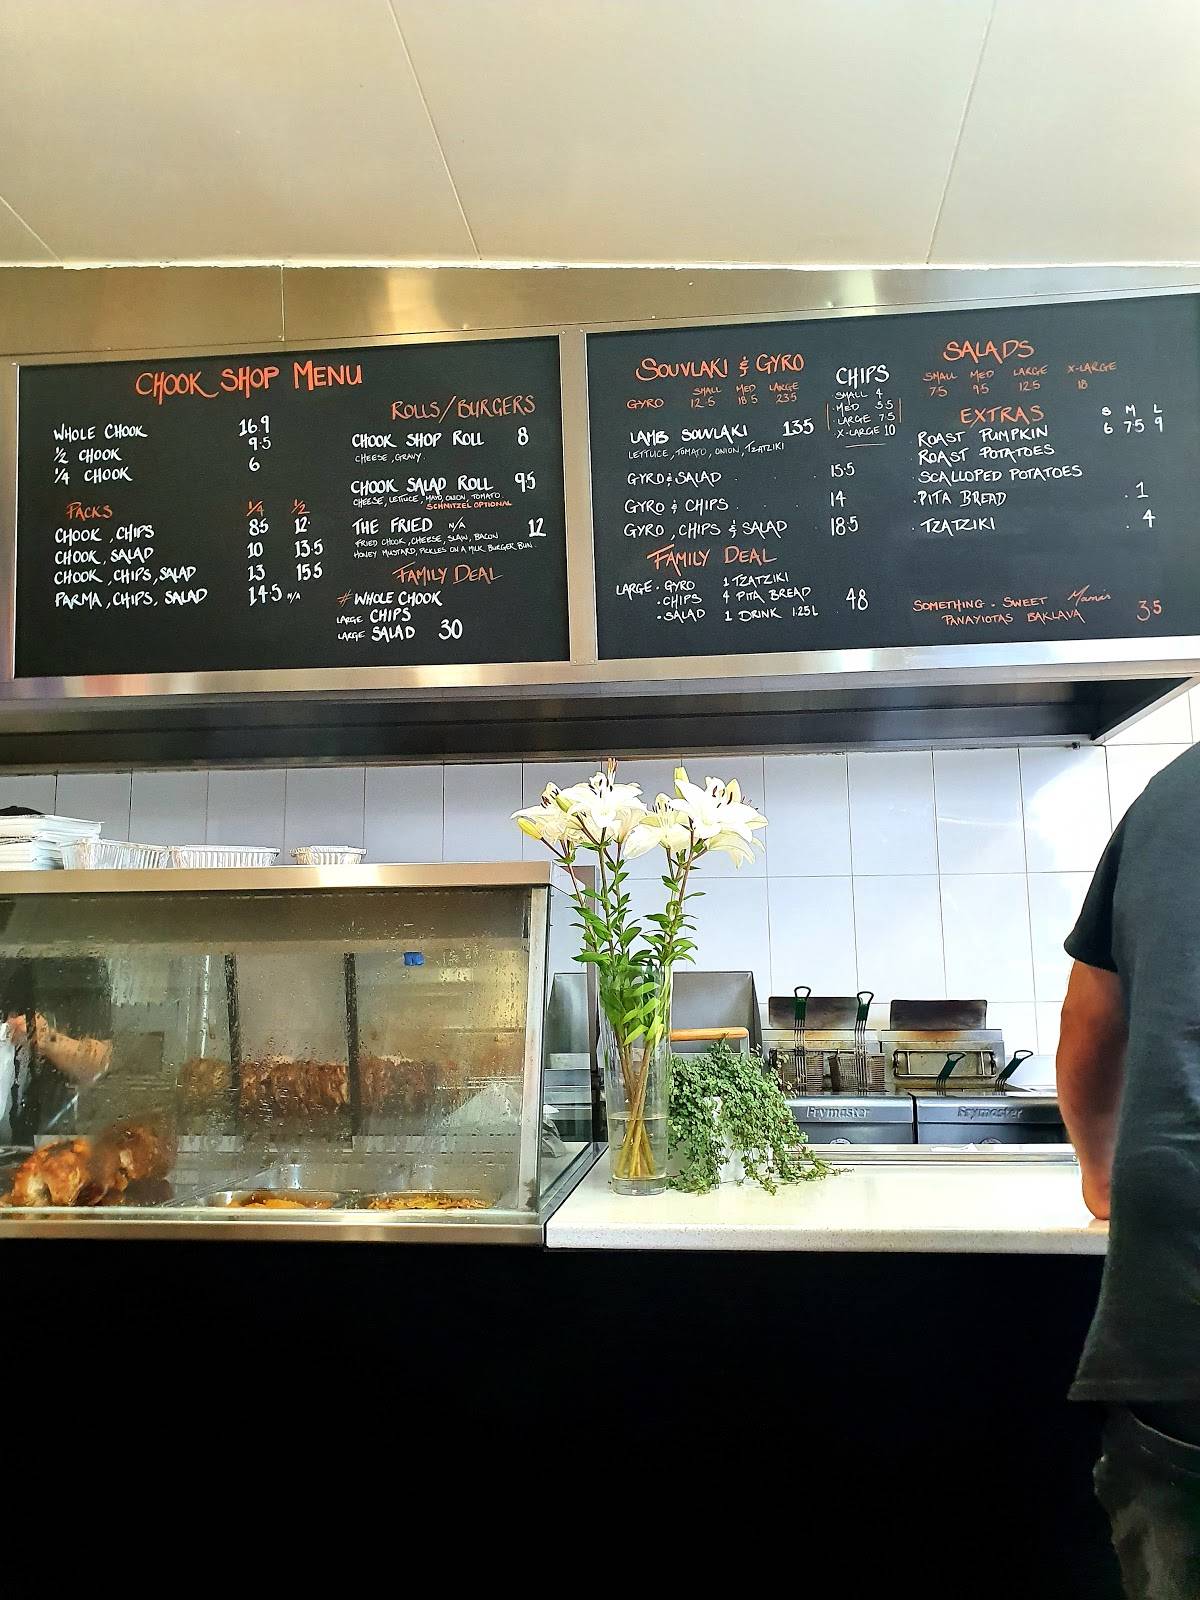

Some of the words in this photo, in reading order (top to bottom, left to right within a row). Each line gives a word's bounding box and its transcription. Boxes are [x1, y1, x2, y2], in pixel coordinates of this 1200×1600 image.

[942, 339, 1035, 364] SALADS
[635, 357, 728, 381] SOUVLAKI
[755, 353, 805, 375] GYRO
[836, 364, 889, 389] CHIPS
[922, 371, 958, 384] SMALL
[969, 369, 995, 382] MED
[1013, 364, 1048, 377] LARGE
[1067, 361, 1118, 375] X-LARGE
[135, 371, 219, 405] CHOOK
[220, 366, 279, 398] SHOP
[293, 360, 363, 391] MENU
[692, 386, 722, 396] SMALL
[736, 384, 756, 394] MED
[769, 382, 799, 392] LARGE
[1077, 379, 1088, 390] 18
[627, 398, 664, 410] GYRO
[835, 391, 868, 405] SMALL
[876, 388, 883, 399] 4
[836, 402, 860, 417] MED
[959, 404, 1045, 427] EXTRAS
[1101, 406, 1112, 416] S
[1125, 404, 1136, 417] M
[1153, 403, 1162, 413] L
[837, 414, 871, 427] LARGE
[53, 423, 96, 443] WHOLE
[104, 423, 148, 439] CHOOK
[351, 433, 398, 449] CHOOK
[405, 432, 442, 448] SHOP
[452, 429, 485, 446] ROLL
[517, 426, 529, 446] 8
[629, 429, 669, 447] LAMB
[681, 424, 748, 444] SOUVLAKI
[836, 426, 880, 438] X-LARGE
[885, 424, 895, 436] 10
[917, 431, 966, 448] ROAST
[978, 424, 1048, 442] PUMPKIN
[1103, 421, 1113, 434] 6
[1154, 416, 1163, 433] 9
[79, 448, 122, 463] CHOOK
[745, 441, 784, 453] TZATZIKI
[918, 448, 969, 467] ROAST
[979, 444, 1055, 463] POTATOES
[83, 467, 133, 484] CHOOK
[249, 457, 260, 472] 6
[627, 472, 664, 486] GYRO
[675, 471, 721, 488] SALAD
[918, 470, 1002, 487] SCALLOPED
[1009, 464, 1083, 481] POTATOES
[350, 479, 399, 496] CHOOK
[406, 477, 447, 496] SALAD
[457, 475, 494, 491] ROLL
[918, 490, 952, 506] PITA
[959, 490, 1007, 507] BREAD
[1136, 481, 1148, 498] 1
[66, 501, 113, 521] PACKS
[425, 503, 472, 511] SCHNITZEL
[473, 500, 512, 509] OPTIONAL
[625, 500, 665, 516] GYRO
[685, 498, 729, 516] CHIPS
[831, 490, 846, 507] 14
[352, 517, 379, 536] THE
[390, 516, 433, 534] FRIED
[448, 516, 466, 533] N/A
[528, 517, 547, 538] 12
[624, 524, 665, 538] GYRO
[742, 521, 788, 540] SALAD
[920, 517, 996, 537] TZATZIKI
[1142, 509, 1156, 528] 4
[354, 538, 378, 548] FRIED
[473, 532, 499, 541] BACON
[110, 547, 154, 564] SALAD
[246, 542, 263, 559] 10
[353, 550, 377, 559] HONEY
[419, 546, 447, 555] PICKLES
[449, 546, 459, 554] ON
[460, 545, 466, 553] A
[468, 545, 487, 553] MILK
[488, 543, 518, 553] BURGER
[646, 543, 711, 576] FAMILY
[724, 545, 778, 566] DEAL
[247, 564, 266, 582] 13
[392, 561, 448, 587] FAMILY
[452, 564, 504, 585] DEAL
[616, 580, 652, 600] LARGE
[664, 581, 696, 592] GYRO
[723, 577, 730, 587] 1
[732, 572, 789, 587] TZATZIKI
[164, 588, 208, 605] SALAD
[354, 591, 394, 606] WHOLE
[397, 591, 443, 607] CHOOK
[722, 591, 730, 604] 4
[736, 590, 765, 603] PITA
[768, 587, 811, 602] BREAD
[845, 588, 869, 611] 48
[912, 599, 985, 613] SOMETHING
[1002, 596, 1049, 608] SWEET
[336, 616, 364, 625] LARGE
[369, 607, 412, 624] CHIPS
[724, 611, 732, 622] 1
[738, 608, 783, 622] DRINK
[942, 613, 1014, 626] PANAYIOTAS
[1027, 609, 1086, 625] BAKLAVA
[337, 631, 366, 642] LARGE
[371, 625, 416, 644] SALAD
[438, 618, 463, 640] 30
